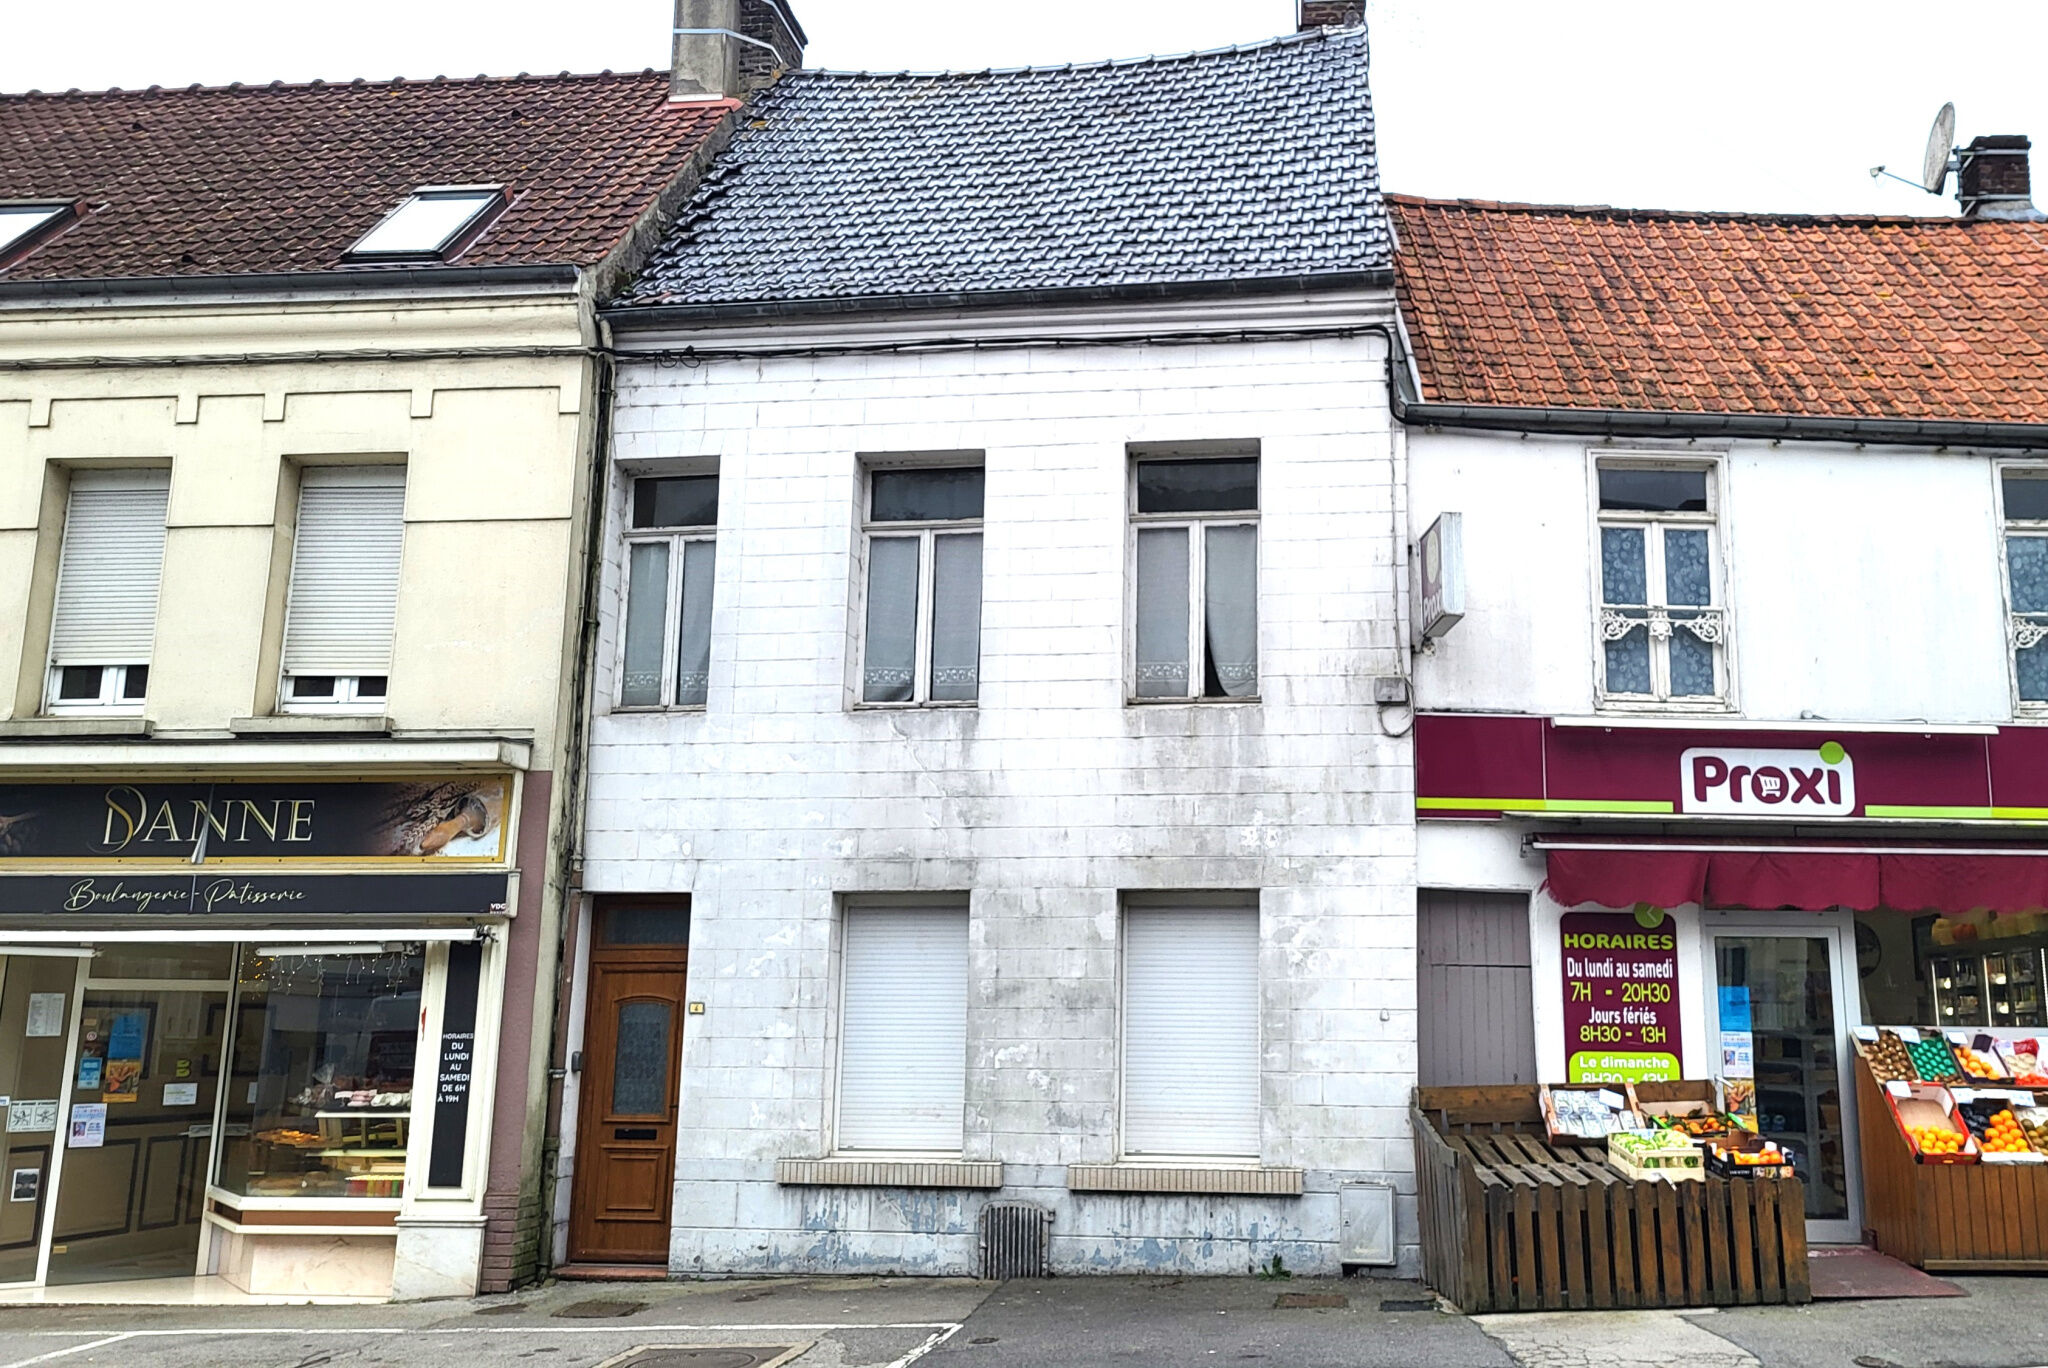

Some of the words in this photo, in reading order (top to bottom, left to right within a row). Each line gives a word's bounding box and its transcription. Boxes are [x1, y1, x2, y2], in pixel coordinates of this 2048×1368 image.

[1692, 741, 1845, 805] Proxi
[64, 878, 189, 912] Boulangerie
[204, 878, 308, 912] Pâtisserie
[1563, 933, 1674, 950] HORAIRES
[1567, 957, 1582, 978] Du
[1584, 958, 1613, 978] lundi
[1616, 963, 1630, 978] au
[1632, 958, 1674, 979] samedi
[1570, 981, 1592, 1002] 7H
[1605, 988, 1613, 996] -
[1621, 982, 1671, 1003] 20H30
[1588, 1006, 1621, 1024] Jours
[1623, 1006, 1657, 1025] fériés
[1579, 1025, 1621, 1042] 8H30
[1640, 1026, 1666, 1043] 13H
[451, 1042, 464, 1050] DU
[444, 1052, 469, 1061] LUNDI
[1579, 1056, 1597, 1069] Le
[1600, 1056, 1670, 1069] dimanche
[449, 1063, 462, 1071] AU
[440, 1073, 470, 1082] SAMEDI
[442, 1084, 453, 1092] DE
[454, 1084, 466, 1092] 6H
[437, 1093, 443, 1103] À
[445, 1095, 459, 1103] 19H
